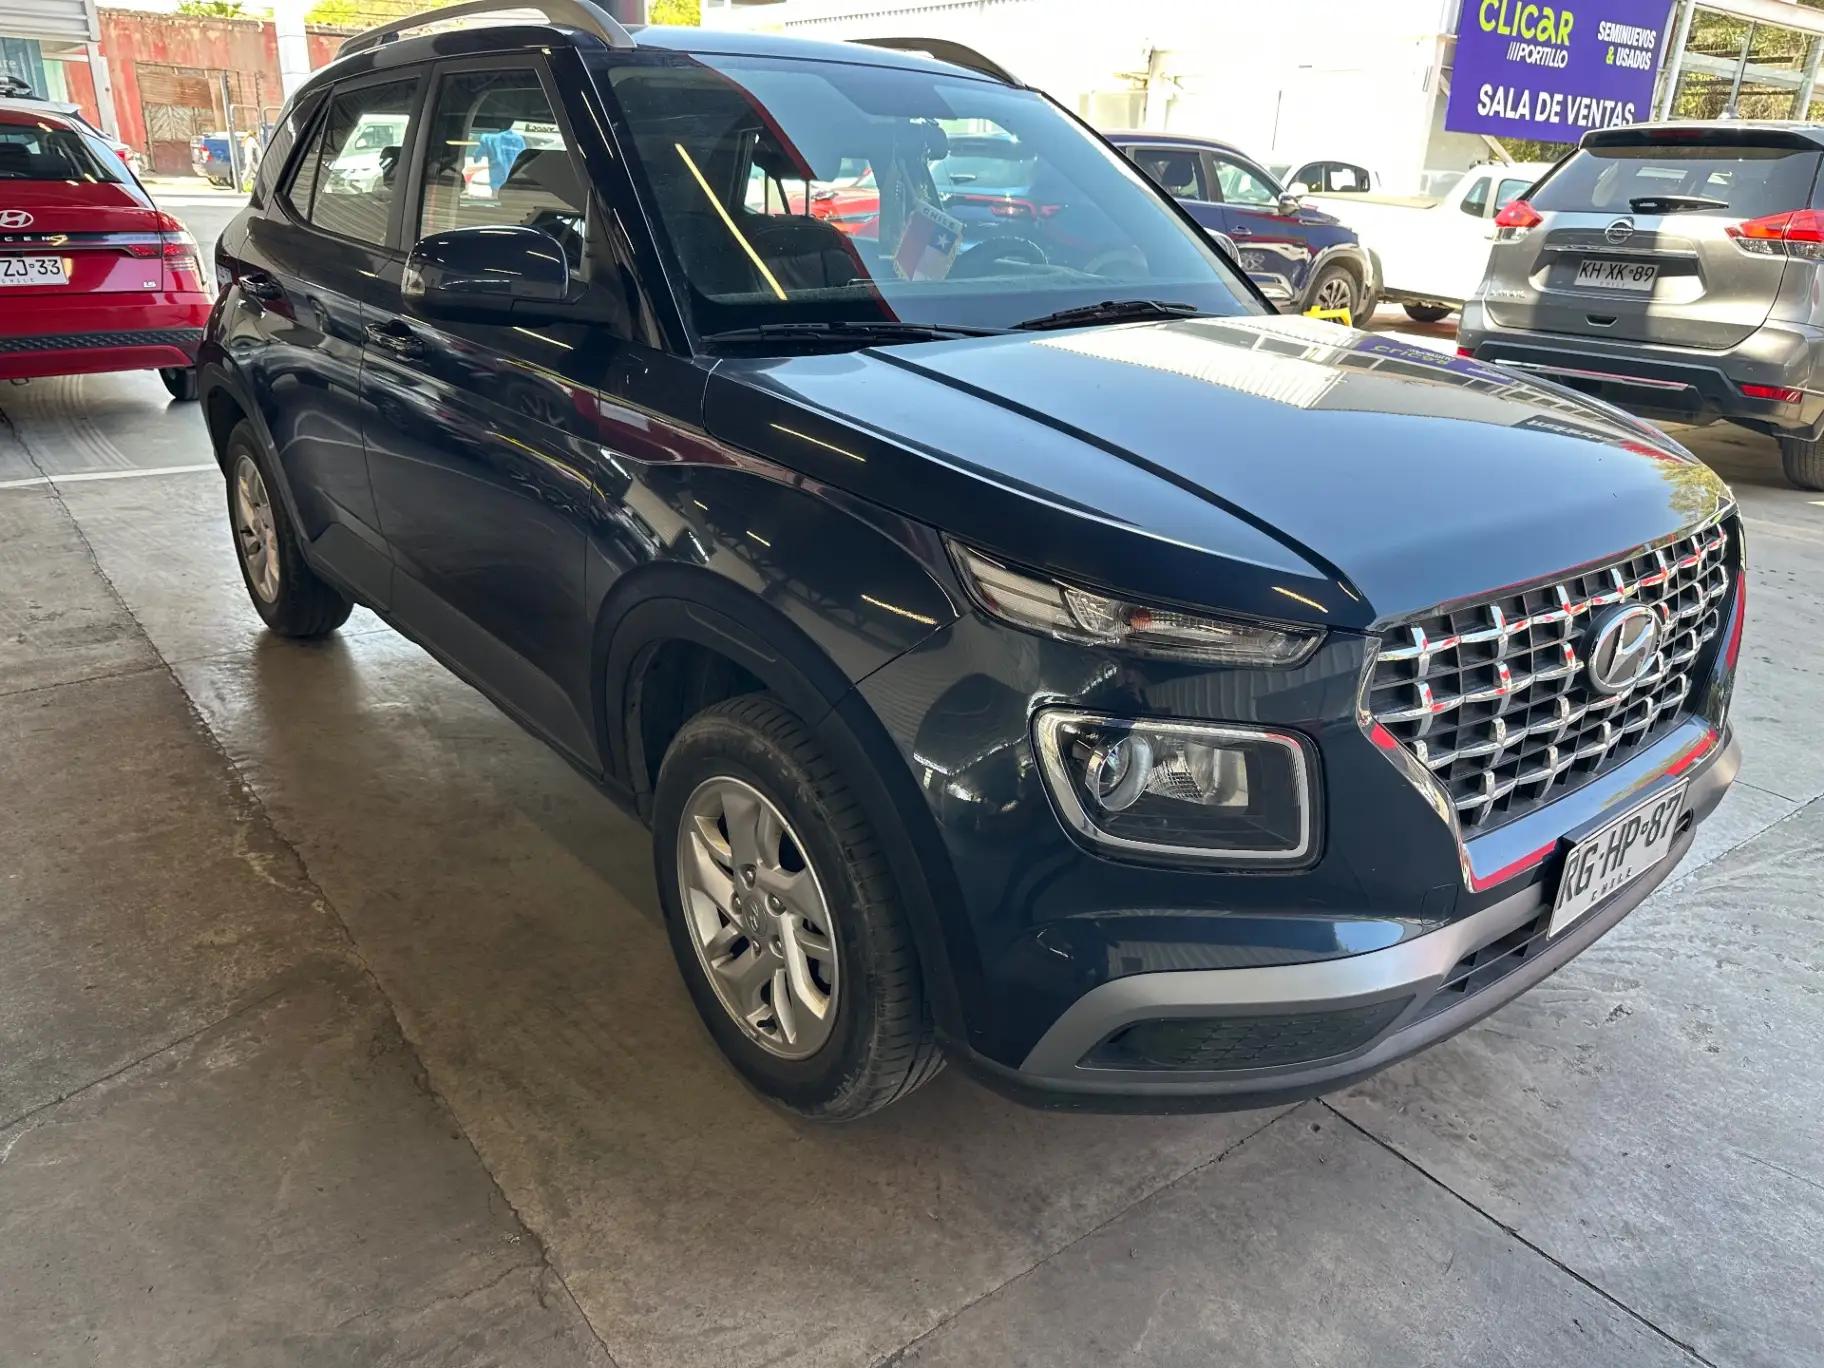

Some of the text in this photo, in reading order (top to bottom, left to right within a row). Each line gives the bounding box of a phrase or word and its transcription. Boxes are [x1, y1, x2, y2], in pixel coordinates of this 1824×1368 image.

[1597, 20, 1656, 49] SEMINUEVOS
[1605, 46, 1652, 71] & USADOS
[1477, 83, 1635, 127] SALA DE VENTAS
[1590, 866, 1633, 902] CHILE
